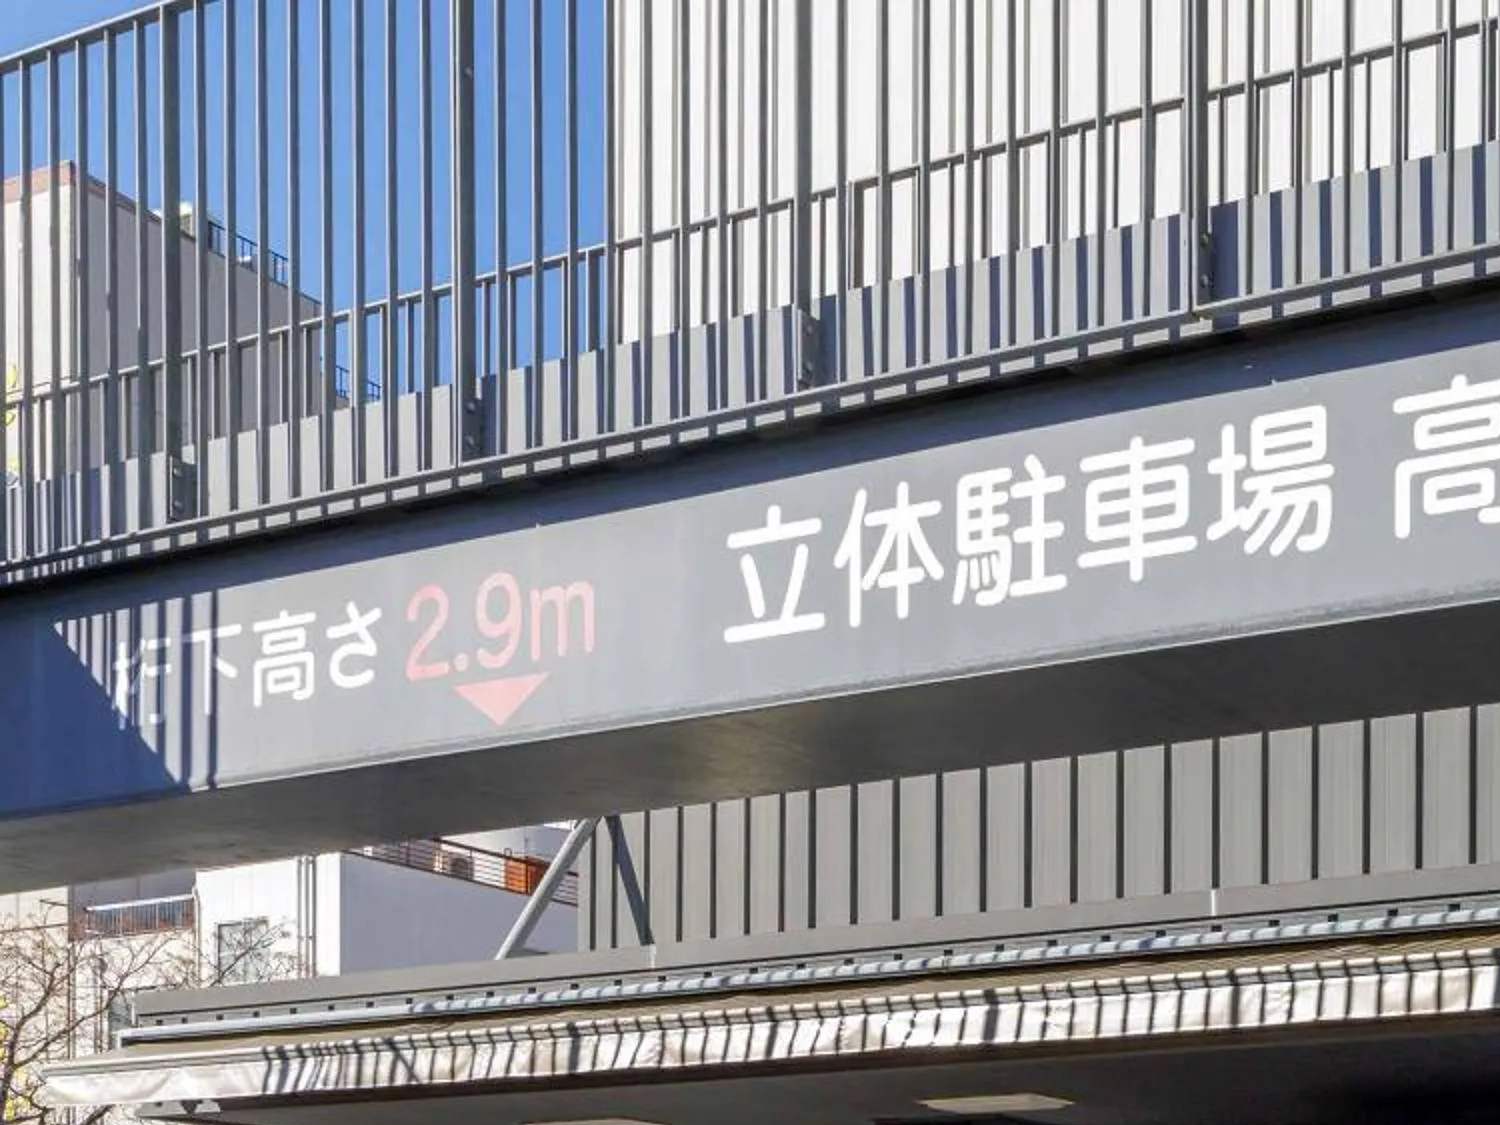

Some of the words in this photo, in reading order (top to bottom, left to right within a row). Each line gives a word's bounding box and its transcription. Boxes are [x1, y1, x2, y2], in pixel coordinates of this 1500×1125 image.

[723, 405, 1334, 643] 立体駐車場
[405, 572, 596, 683] 2.9m
